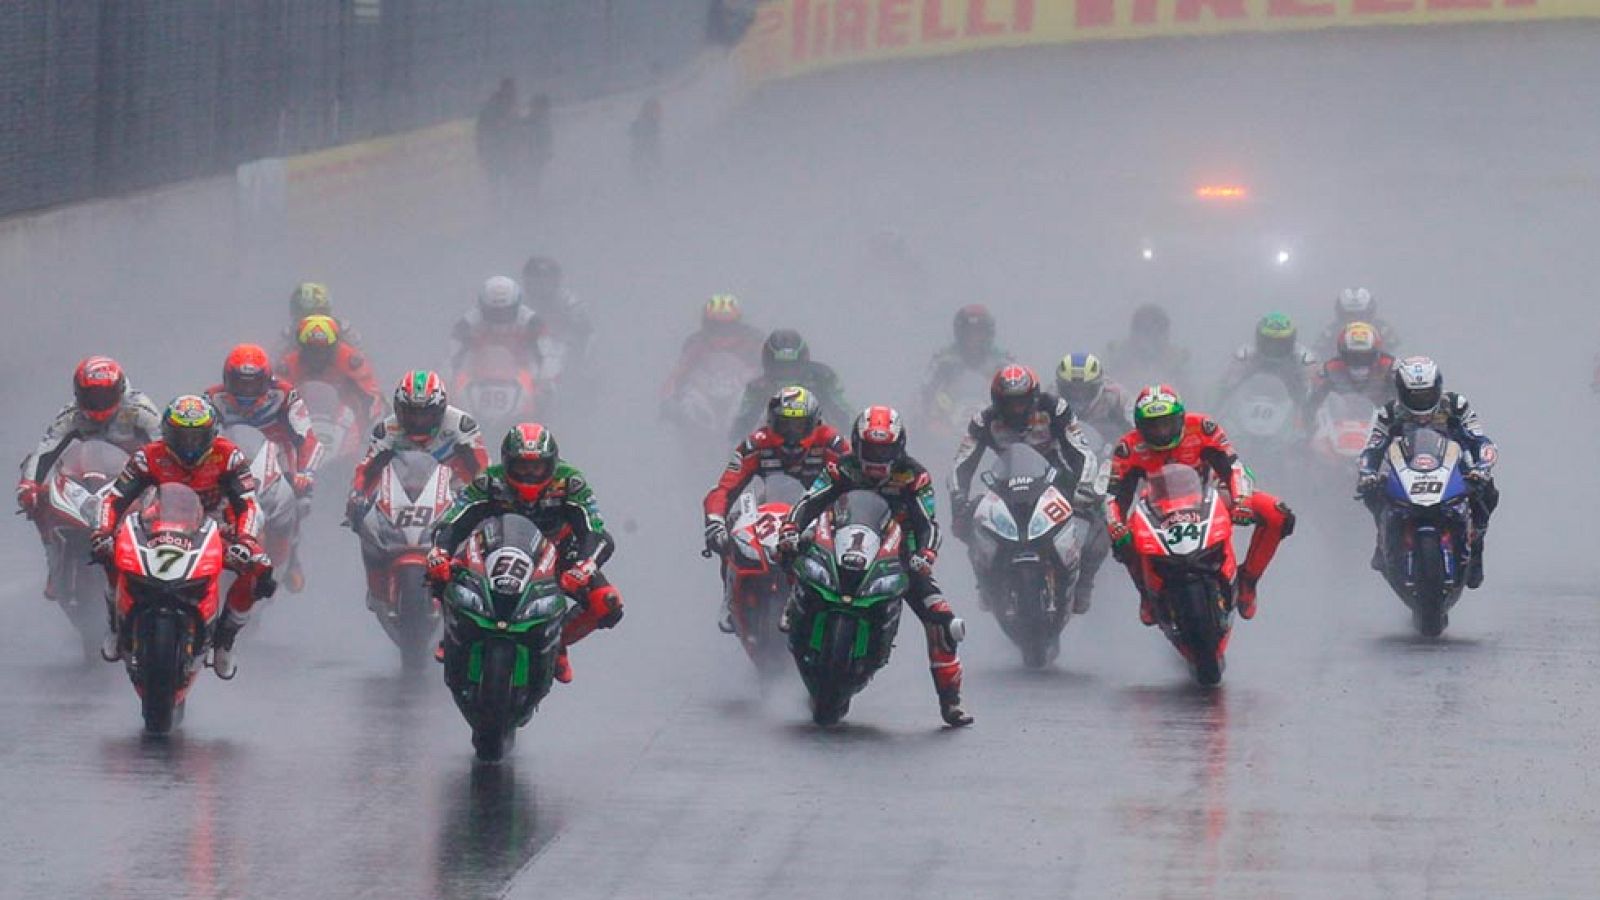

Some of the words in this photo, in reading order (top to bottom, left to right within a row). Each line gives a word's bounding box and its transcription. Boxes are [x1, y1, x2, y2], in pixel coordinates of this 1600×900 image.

[395, 506, 433, 527] 69
[1042, 498, 1072, 523] 81
[846, 531, 866, 552] 1
[1168, 523, 1201, 545] 34
[157, 548, 184, 573] 7
[492, 556, 531, 581] 66
